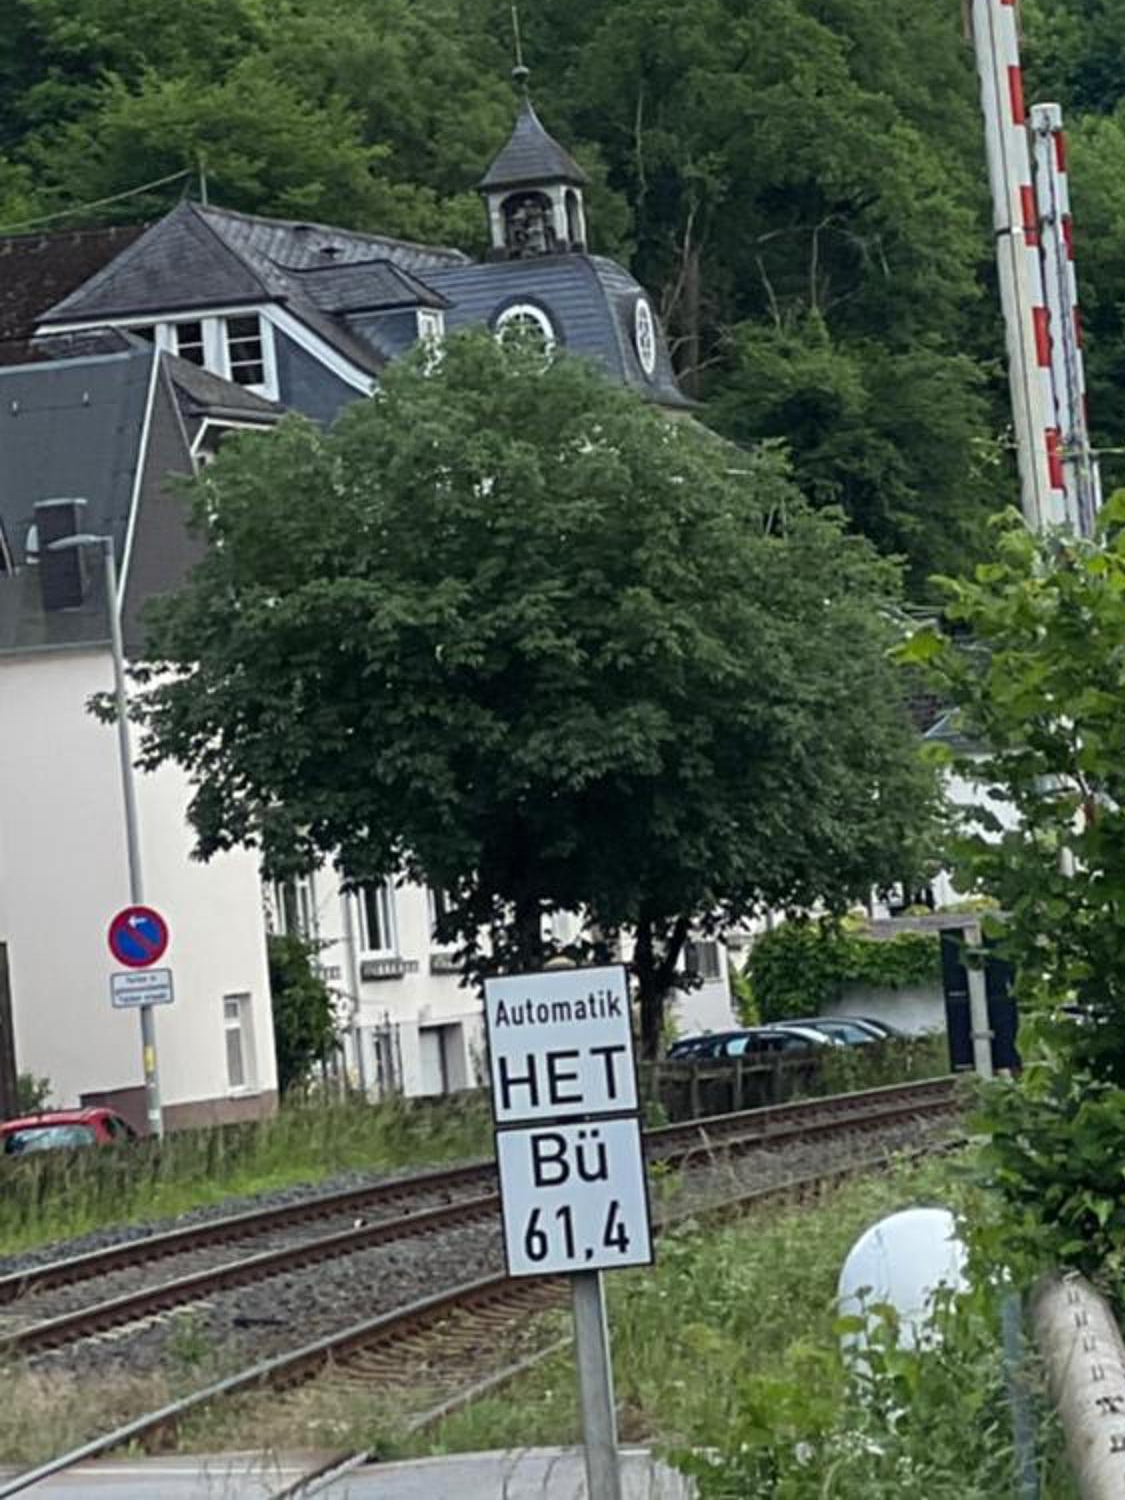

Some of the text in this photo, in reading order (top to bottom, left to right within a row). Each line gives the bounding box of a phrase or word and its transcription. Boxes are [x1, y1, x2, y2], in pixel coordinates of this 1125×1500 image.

[495, 989, 622, 1027] Automatik
[498, 1044, 627, 1110] HET
[530, 1128, 609, 1188] Bü
[524, 1199, 630, 1262] 61,4
